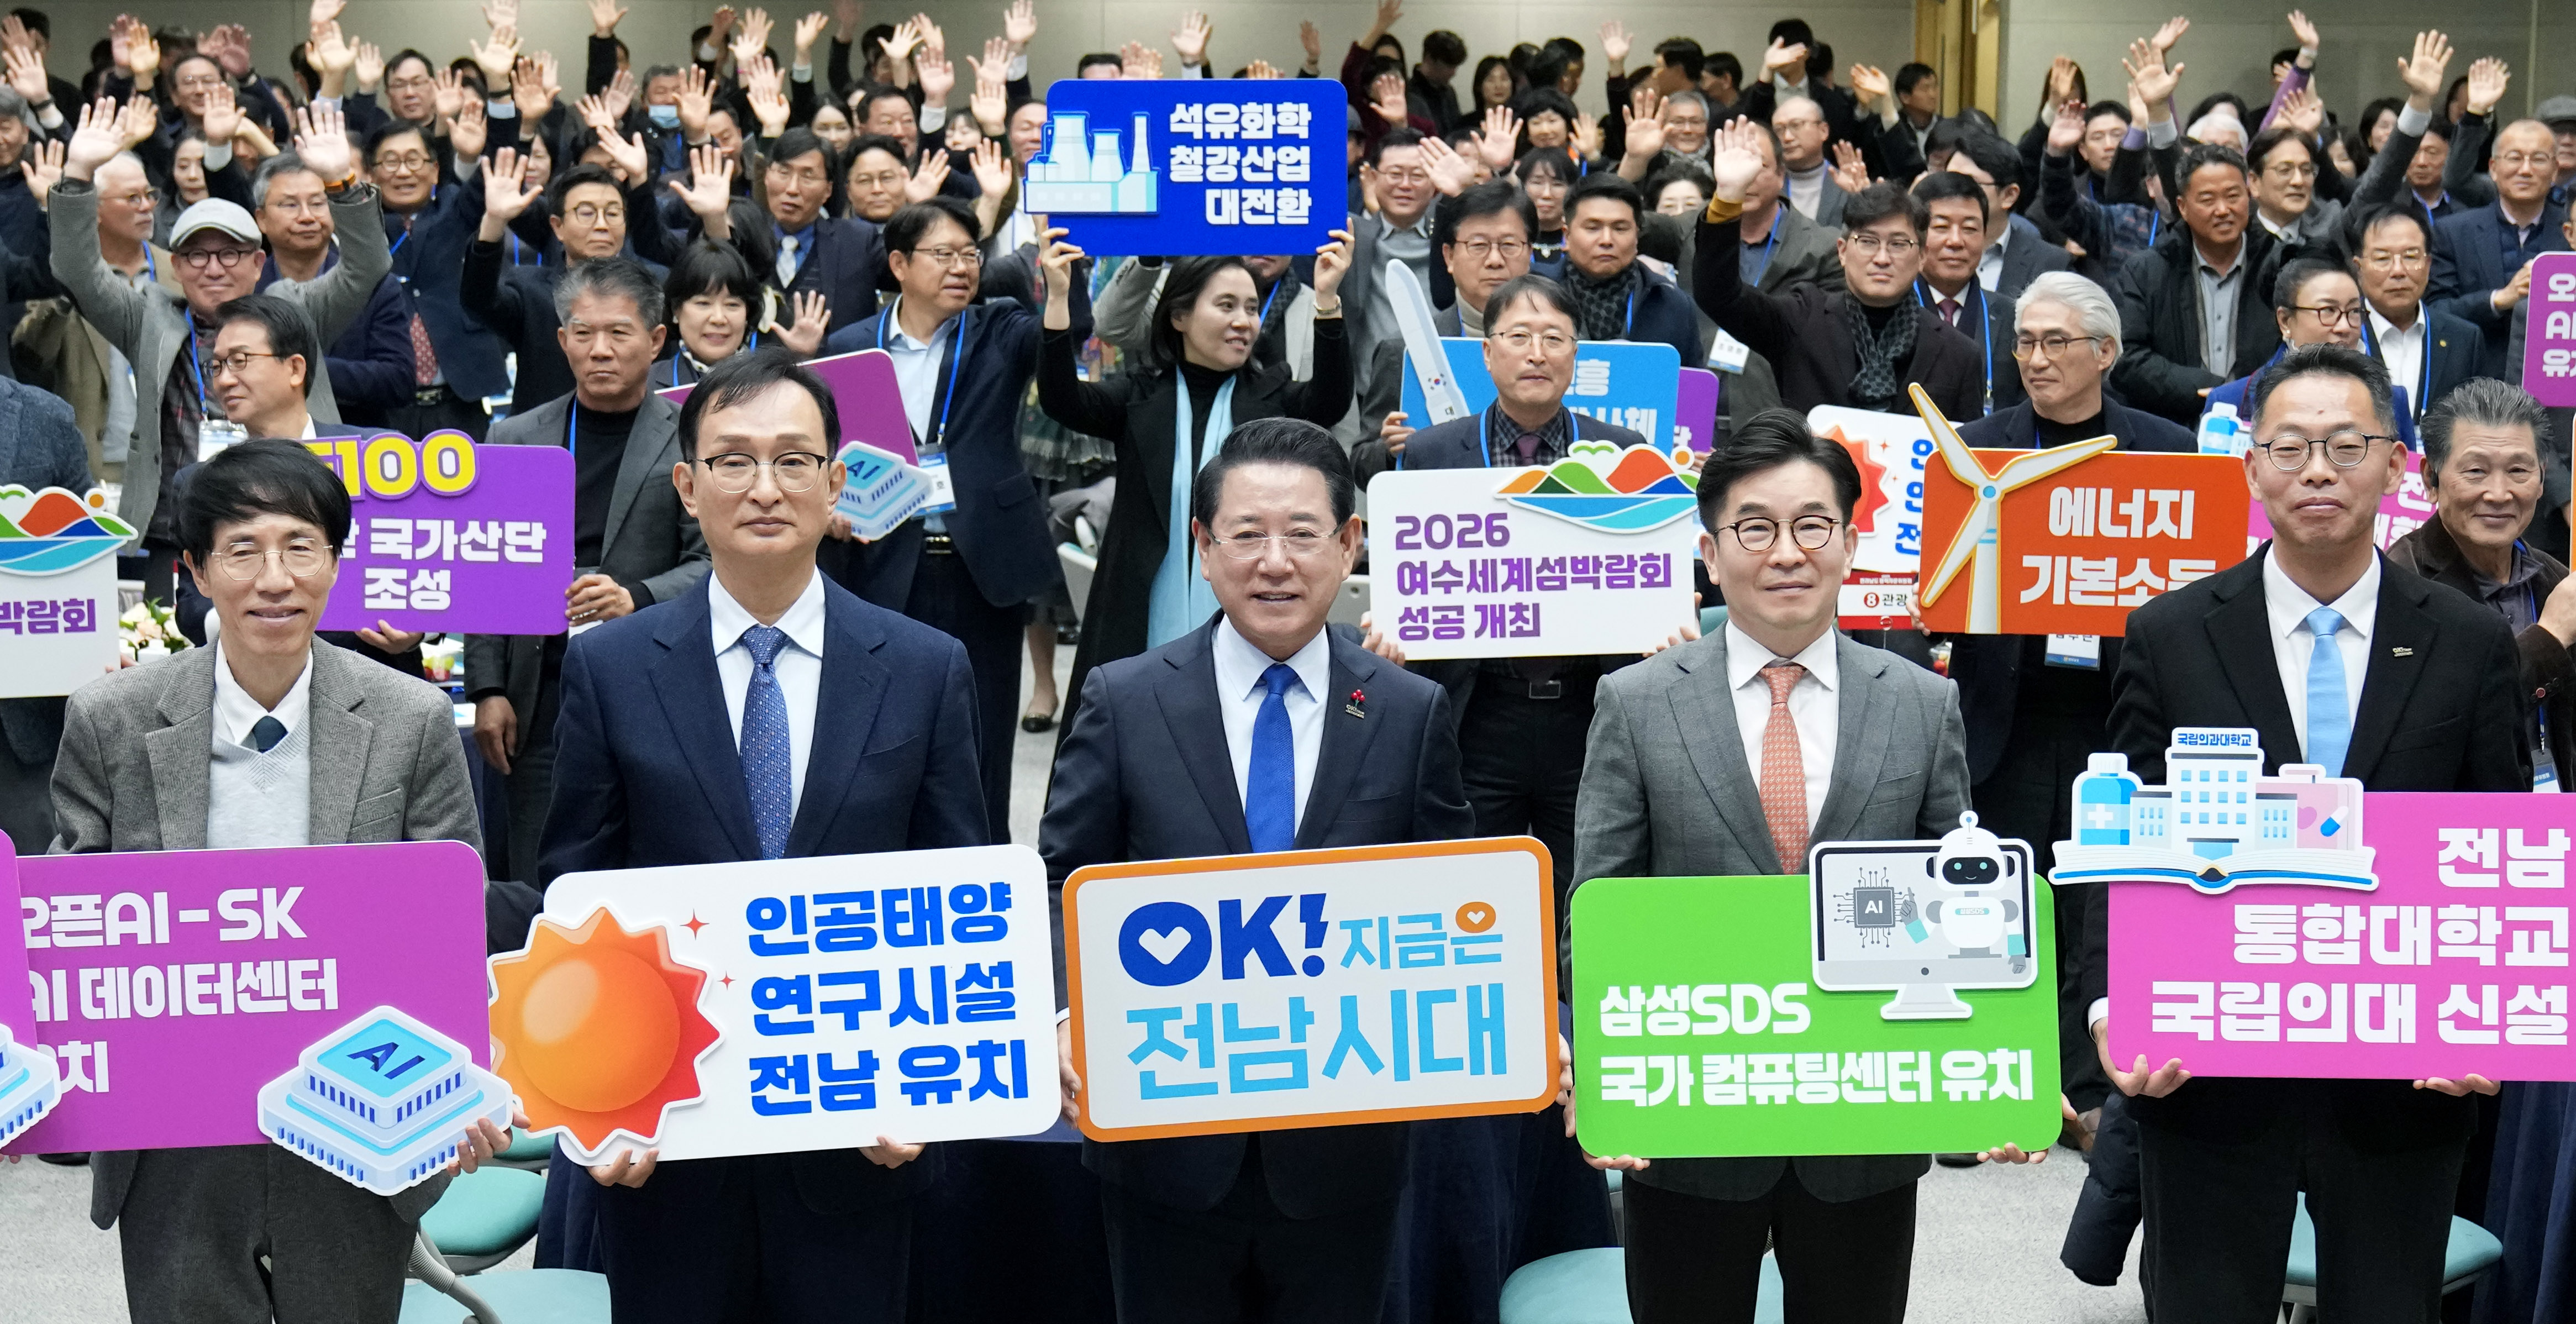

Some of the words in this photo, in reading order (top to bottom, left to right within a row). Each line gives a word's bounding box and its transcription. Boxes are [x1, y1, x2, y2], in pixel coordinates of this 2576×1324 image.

[1170, 102, 1312, 139] 석유화학
[1170, 145, 1311, 182] 철강산업
[1206, 187, 1312, 224] 대전환
[847, 460, 881, 480] AI
[1395, 513, 1510, 550] 2026
[2049, 487, 2195, 540] 에너지
[370, 518, 546, 563] 국가산단
[364, 568, 451, 611] 조성
[1396, 553, 1671, 596] 여수세계섬박람회
[1399, 606, 1464, 641] 성공
[1474, 602, 1541, 639] 개최
[2178, 733, 2252, 747] 국립의과대학교
[2437, 828, 2571, 889] 전남
[217, 886, 308, 942] SK
[745, 881, 1012, 957] 인공태양
[1864, 900, 1883, 913] AI
[1118, 893, 1329, 987] OK!
[1339, 901, 1503, 970] 지금은
[2233, 903, 2569, 967] 통합대학교
[78, 958, 339, 1020] 데이터센터
[750, 960, 1016, 1037] 연구시설
[1600, 983, 1811, 1037] 삼성SDS
[2152, 981, 2416, 1044] 국립의대
[2437, 984, 2569, 1045] 신설
[37, 1040, 109, 1093] 치
[347, 1042, 425, 1079] AI
[1126, 983, 1507, 1101] 전남시대
[749, 1049, 880, 1117] 전남
[898, 1039, 1029, 1106] 유치
[1600, 1055, 1695, 1107] 국가
[1702, 1050, 1932, 1106] 컴퓨팅센터
[1940, 1048, 2033, 1101] 유치
